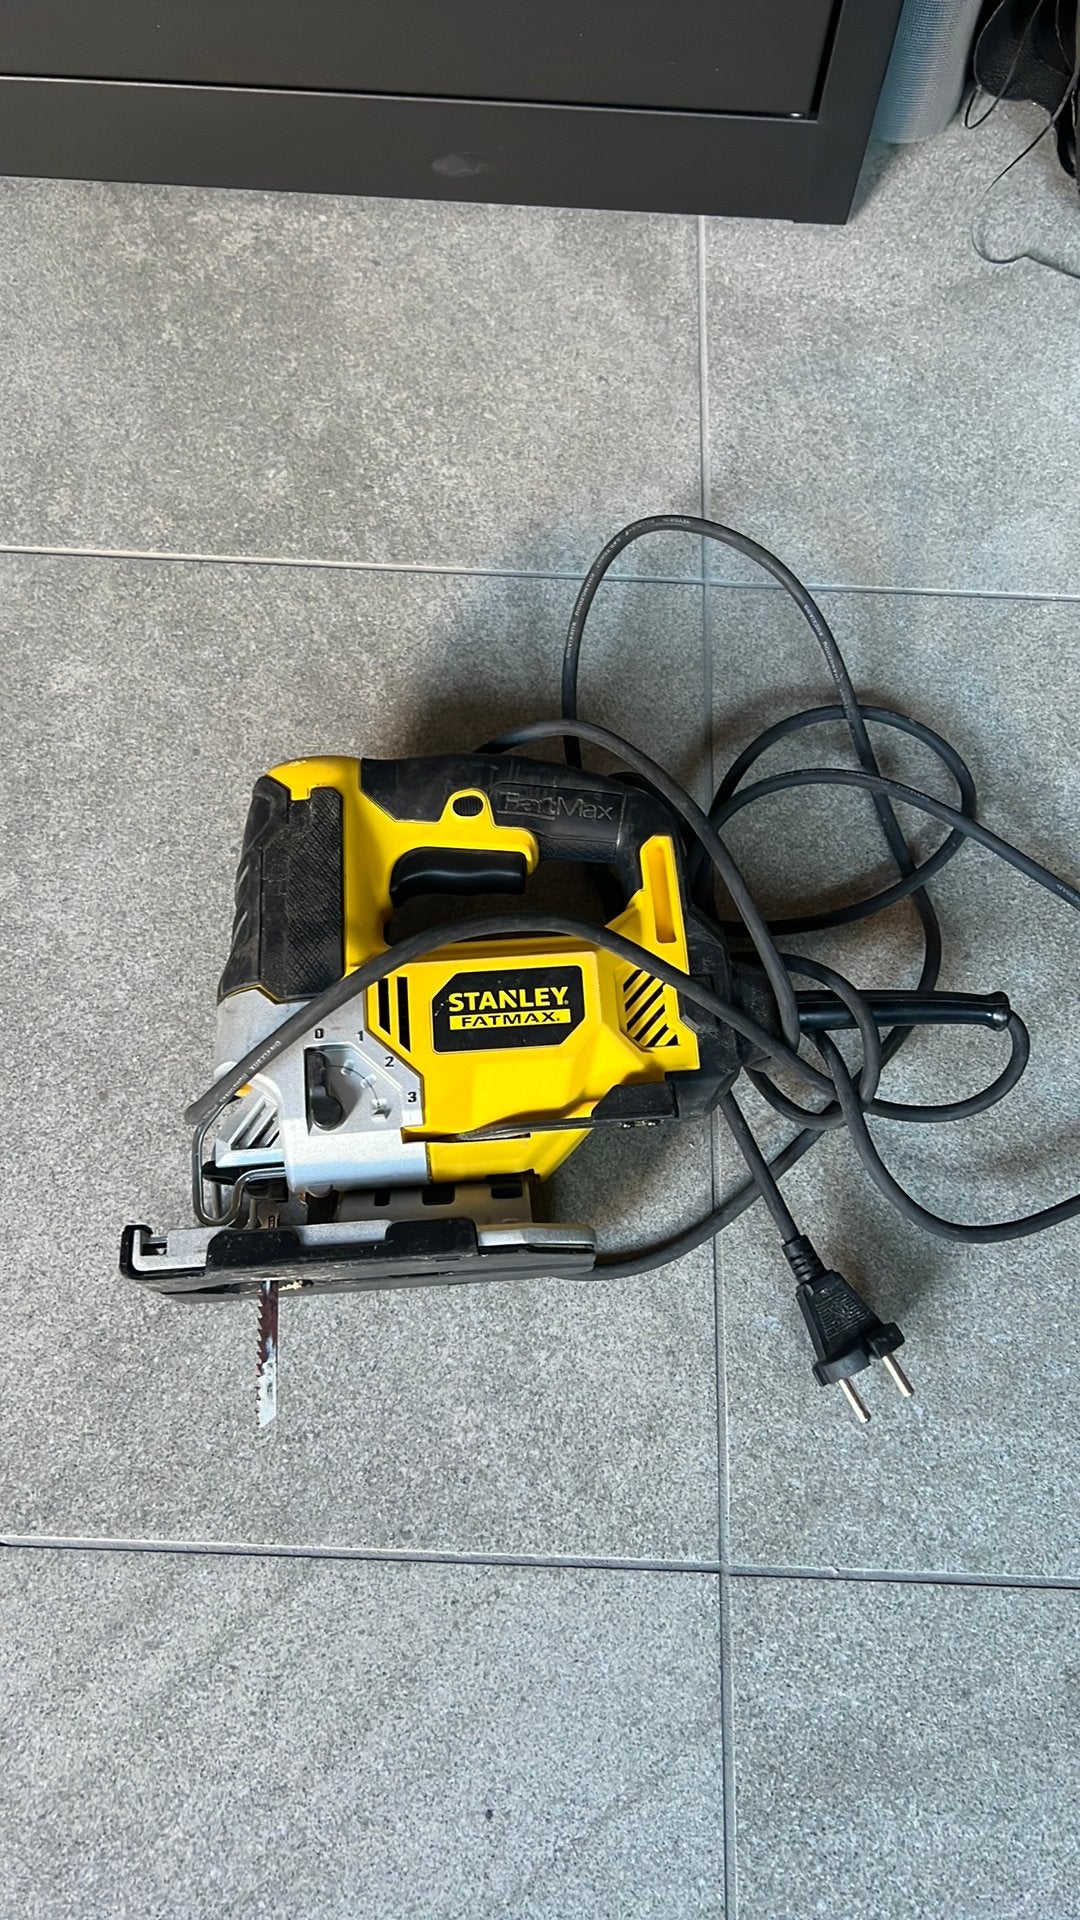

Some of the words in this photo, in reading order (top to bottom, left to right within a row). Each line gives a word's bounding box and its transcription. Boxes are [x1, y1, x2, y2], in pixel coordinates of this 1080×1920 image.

[497, 790, 613, 821] FatMax
[448, 986, 569, 1012] STANLEY
[461, 1011, 556, 1028] FATMAX
[356, 1030, 364, 1042] 1
[384, 1056, 395, 1068] 2
[407, 1091, 417, 1103] 3
